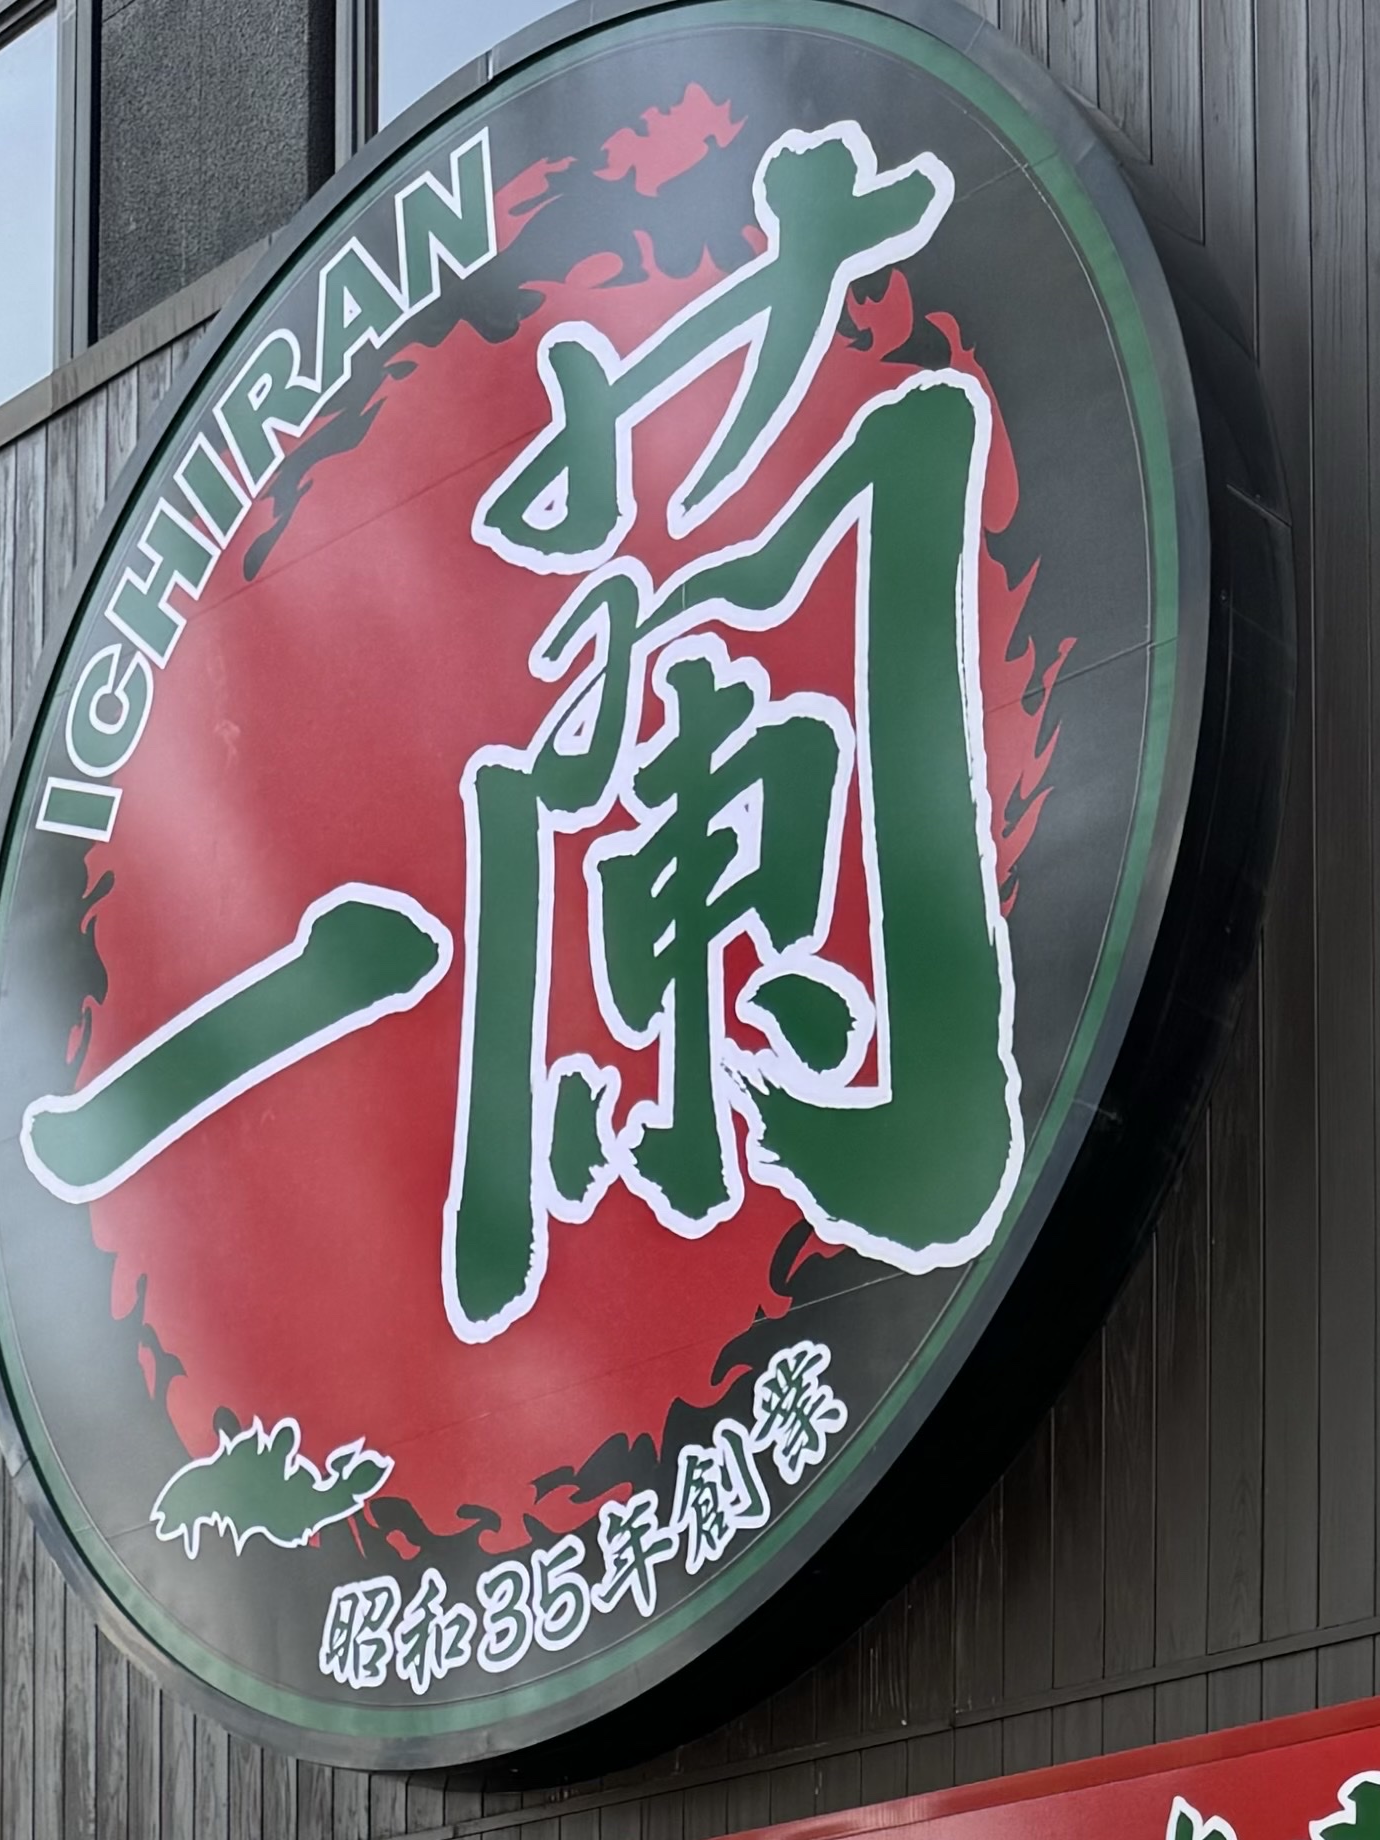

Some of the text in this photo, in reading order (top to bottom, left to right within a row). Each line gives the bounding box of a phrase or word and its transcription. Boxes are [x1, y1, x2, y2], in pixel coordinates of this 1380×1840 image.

[35, 126, 499, 842] ICHIRAN
[319, 1339, 848, 1695] 昭和35年創業
